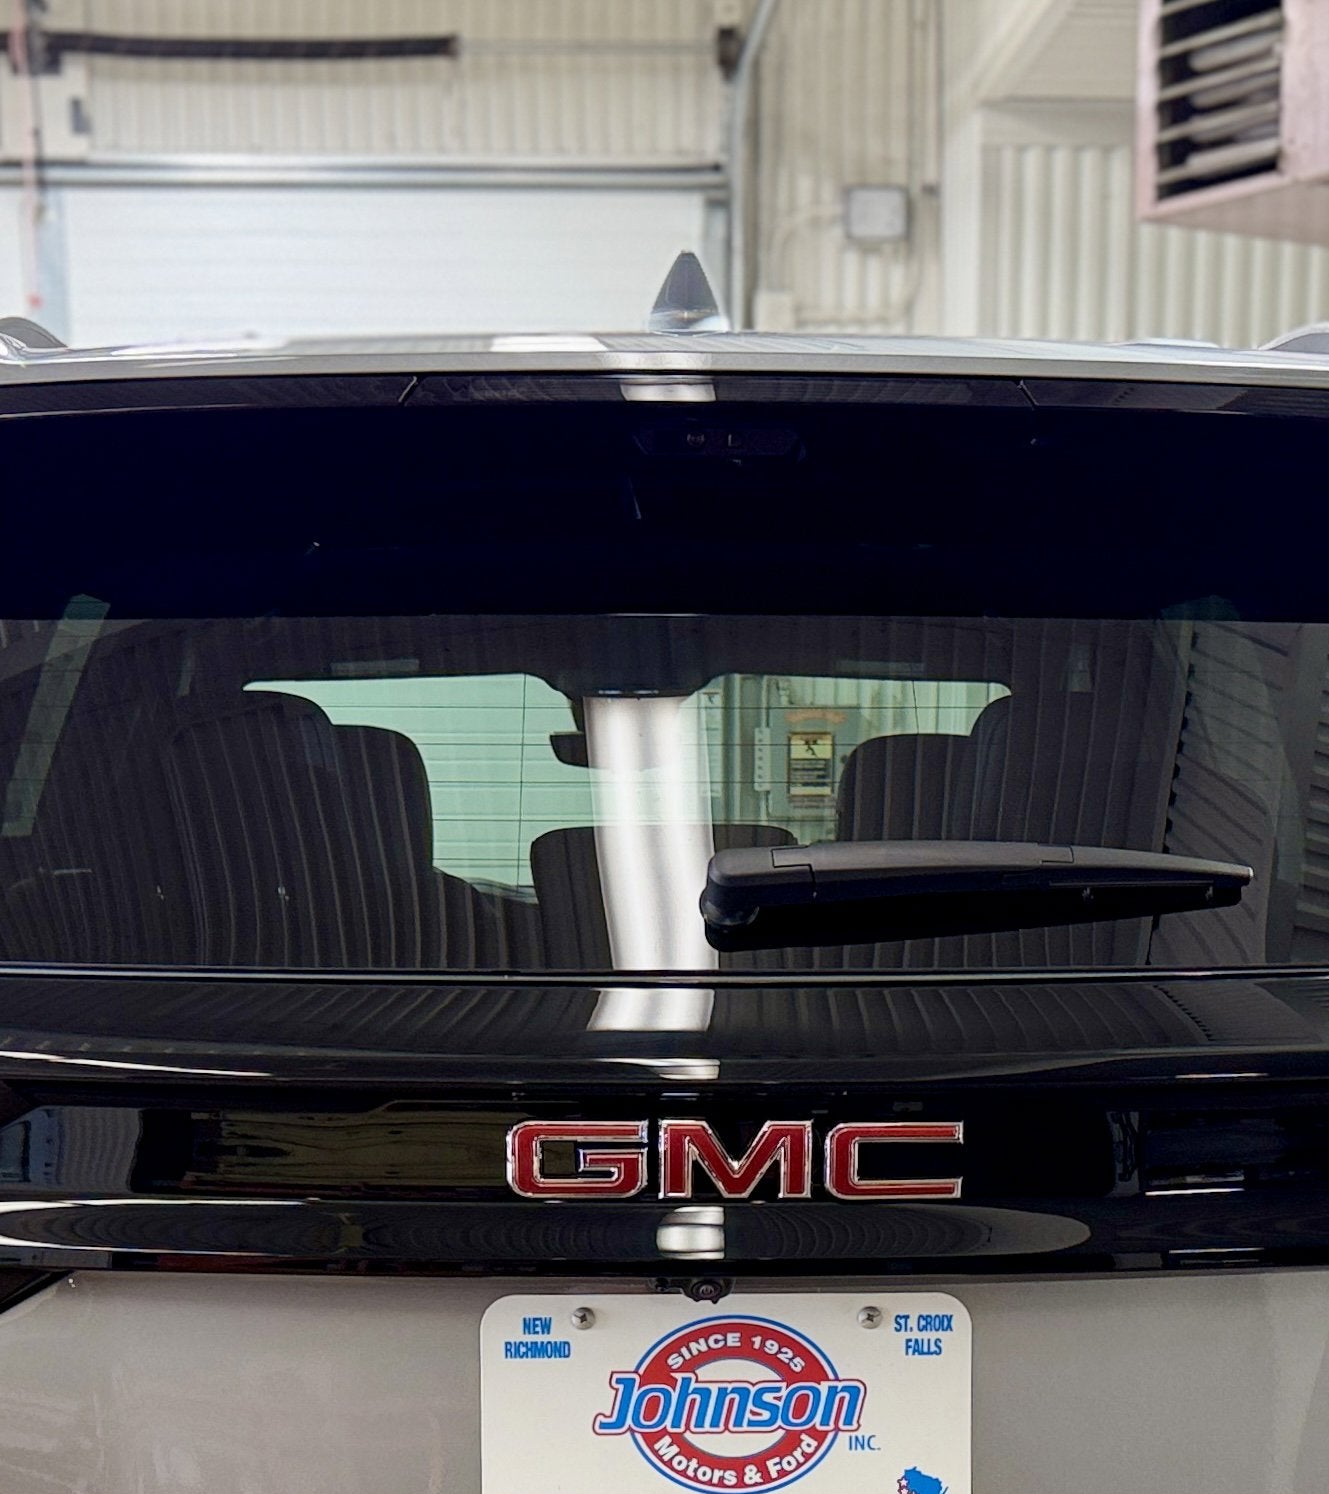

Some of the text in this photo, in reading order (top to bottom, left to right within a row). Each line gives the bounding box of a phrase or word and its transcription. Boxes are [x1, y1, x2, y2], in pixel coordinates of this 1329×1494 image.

[506, 1119, 964, 1199] GMC
[522, 1317, 552, 1335] NEW
[894, 1314, 953, 1332] ST. CROIX
[504, 1341, 571, 1359] RICHMOND
[666, 1332, 806, 1373] SINCE 1925
[905, 1338, 942, 1356] FALLS
[593, 1371, 867, 1435] Johnson
[848, 1435, 881, 1451] INC.
[653, 1433, 819, 1487] Motors & Ford
